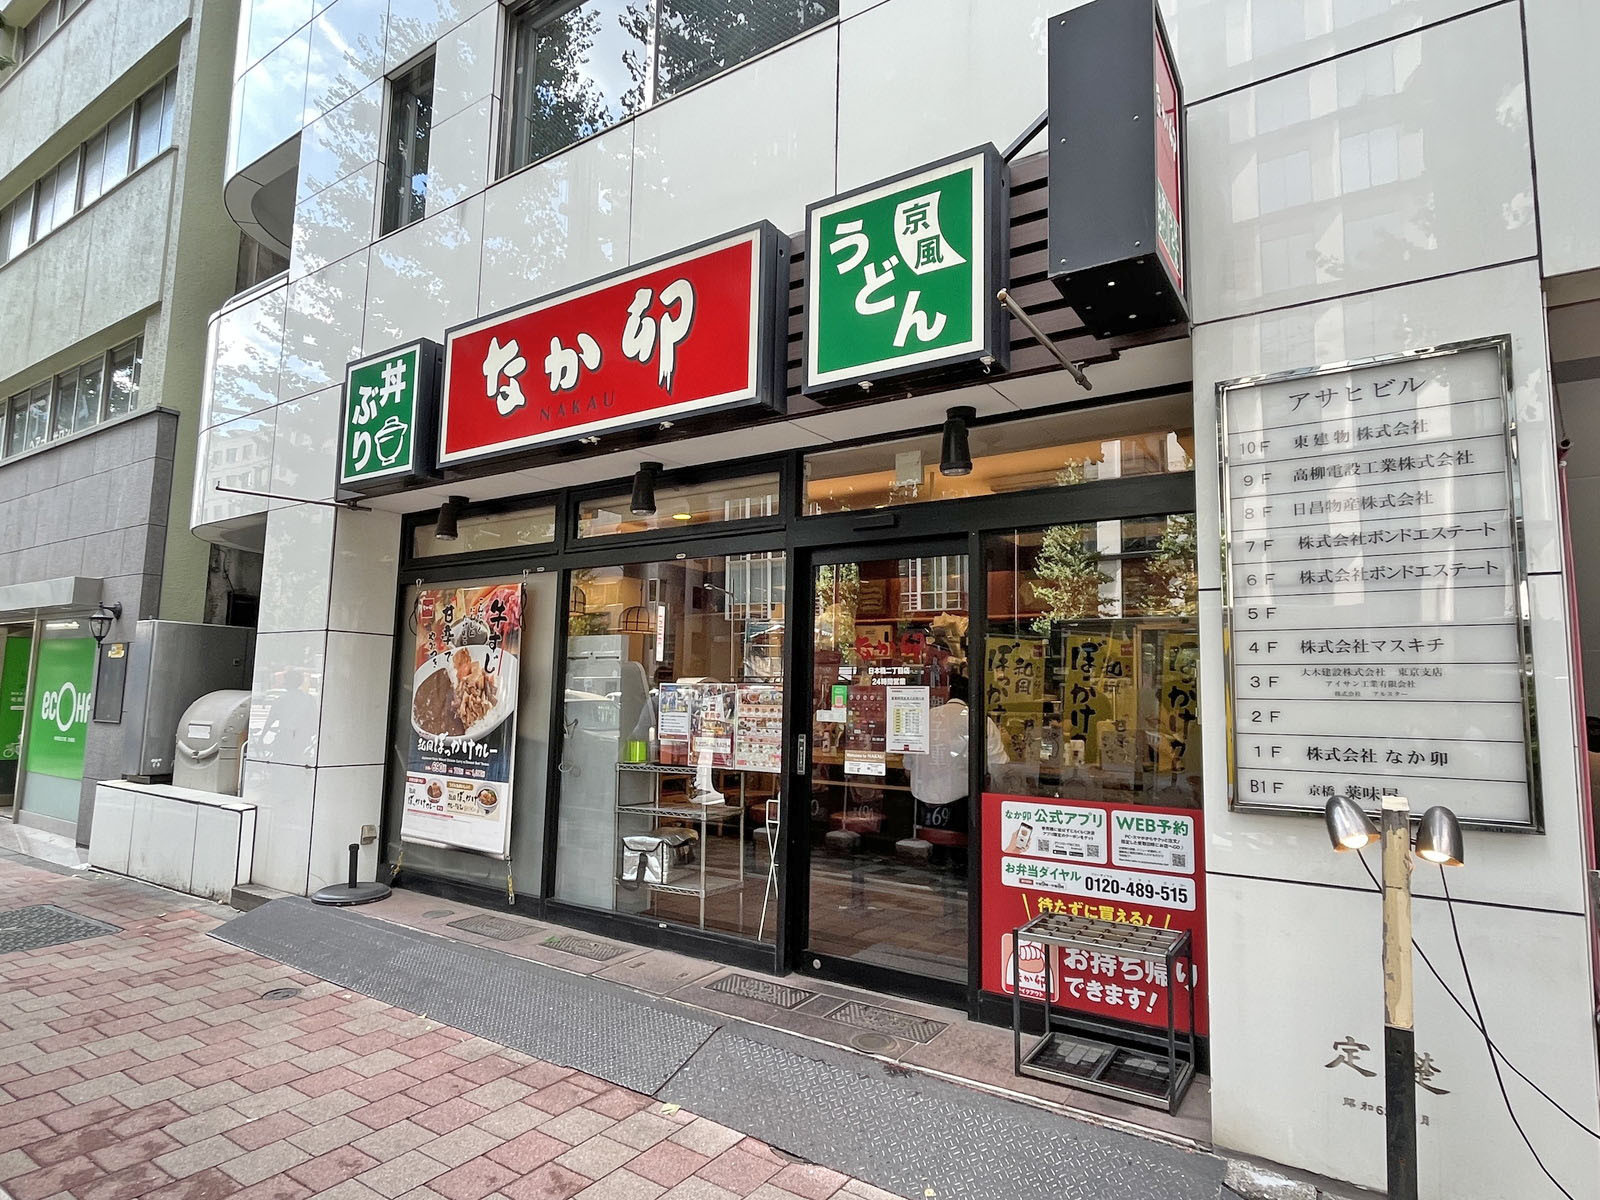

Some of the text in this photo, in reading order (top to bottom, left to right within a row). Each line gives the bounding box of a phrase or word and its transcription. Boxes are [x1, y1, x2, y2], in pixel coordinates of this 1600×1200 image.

[901, 202, 945, 270] 京風
[829, 218, 948, 348] うどん
[481, 278, 696, 418] なか卯
[539, 391, 617, 422] NAKAU
[1288, 376, 1427, 412] アサヒビル
[1293, 449, 1475, 483] 高柳電設工業株式会社
[1293, 490, 1434, 517] 日昌物産株式会社
[1297, 522, 1497, 551] 株式会社ボンドエステート
[1299, 560, 1499, 585] 株式会社ボンドエステート
[1300, 637, 1446, 655] 株式会社マスキチ
[1398, 667, 1443, 677] 東京支店
[1005, 809, 1104, 828] なか卯 公式アプリ
[1116, 815, 1189, 837] WEB予約
[1005, 862, 1082, 882] お弁当ダイヤル
[1085, 876, 1188, 904] 0120-489-515
[1063, 975, 1158, 1014] できます!
